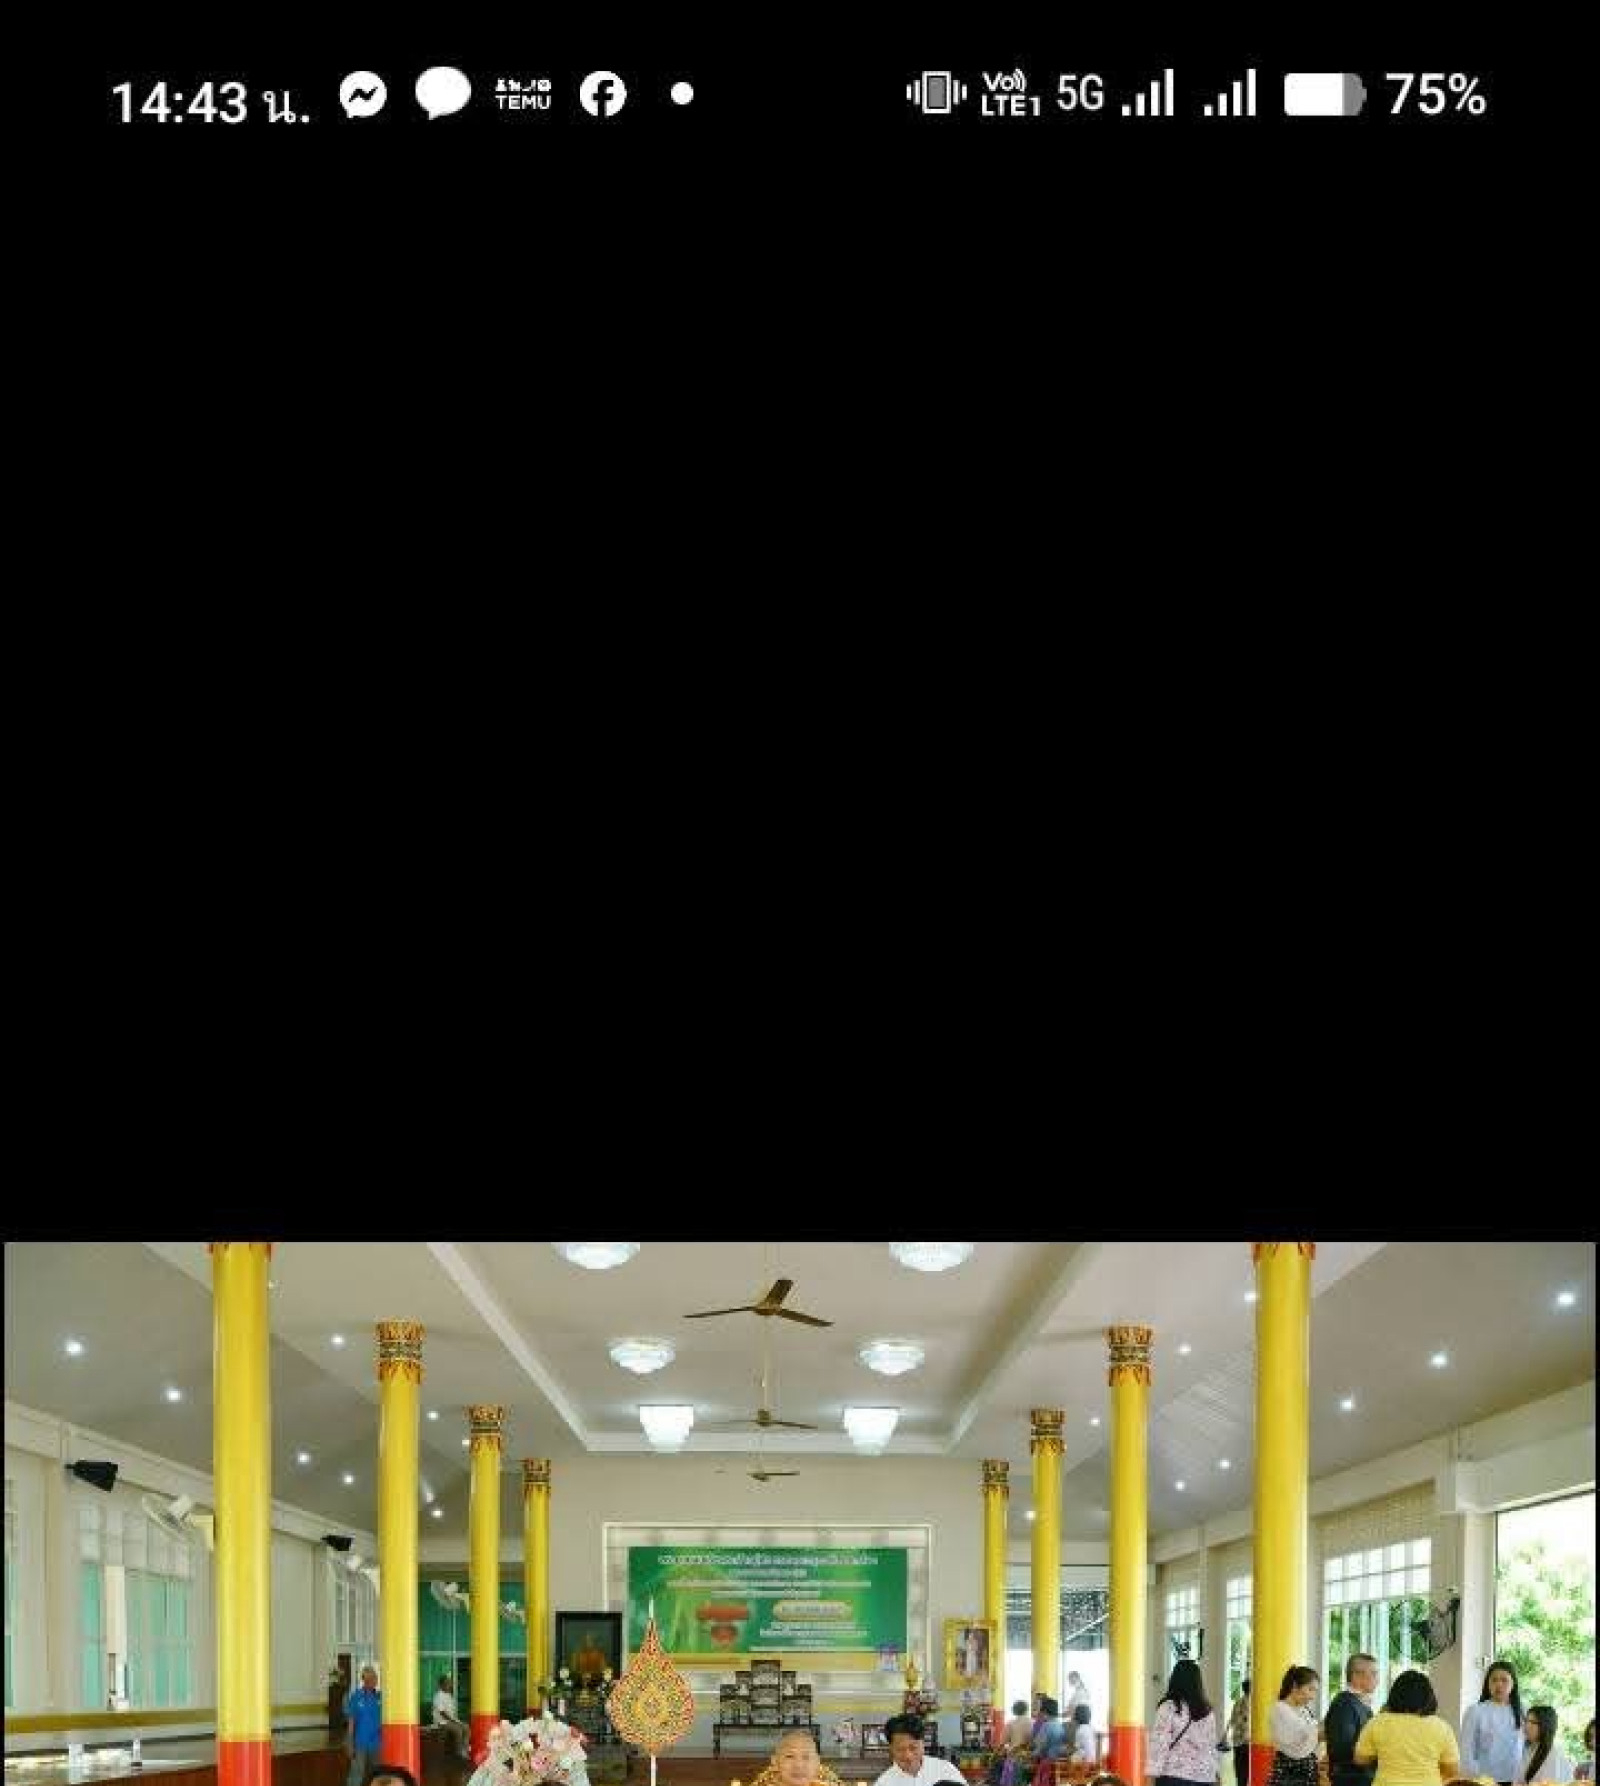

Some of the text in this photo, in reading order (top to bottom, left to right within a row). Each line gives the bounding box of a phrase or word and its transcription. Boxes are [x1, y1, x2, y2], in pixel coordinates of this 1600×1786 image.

[112, 81, 310, 125] 14:43 น.
[494, 94, 552, 110] TEMU
[1057, 73, 1104, 110] 5G
[1385, 72, 1487, 115] 75%
